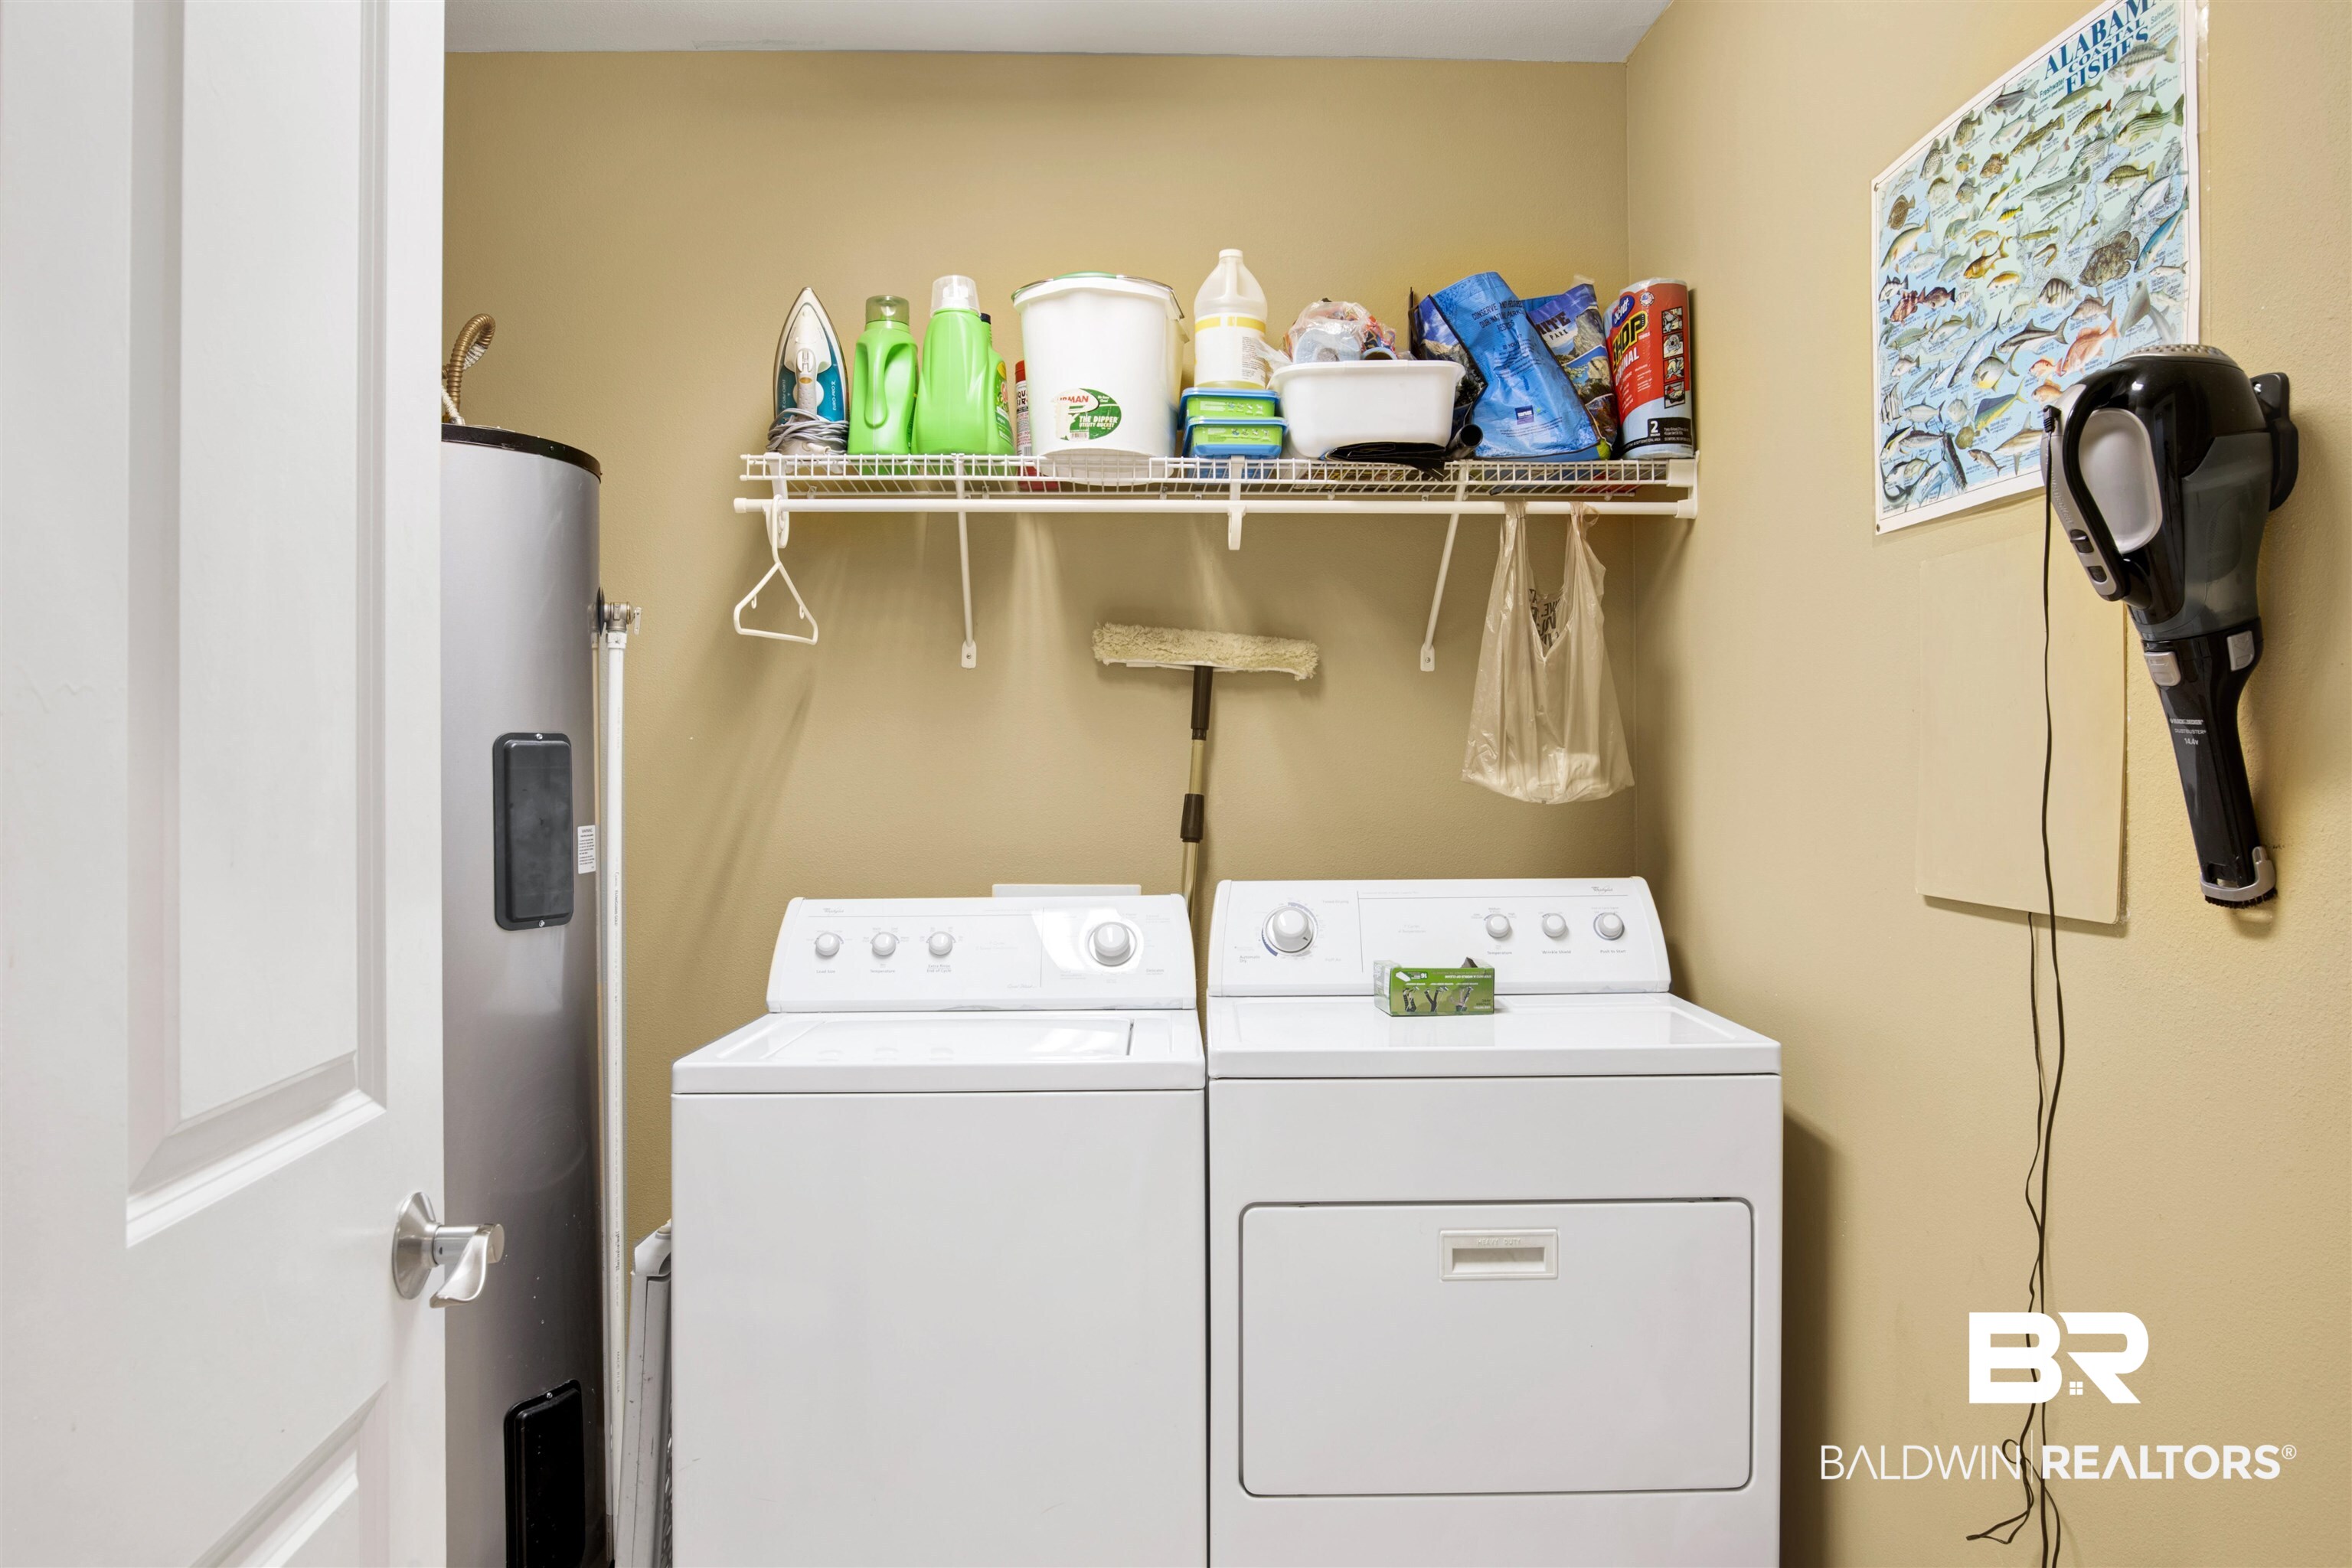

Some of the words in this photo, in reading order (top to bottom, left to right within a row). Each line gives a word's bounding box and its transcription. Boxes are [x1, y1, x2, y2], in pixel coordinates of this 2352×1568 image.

[2043, 0, 2161, 80] ALABAM
[2069, 18, 2145, 73] COASTAL
[2065, 25, 2148, 95] FISHES
[2039, 79, 2065, 97] Freshwater
[1472, 302, 1498, 320] CONSERVE
[1479, 319, 1491, 328] OUR
[1549, 329, 1568, 341] PARK
[1650, 420, 1658, 433] 2
